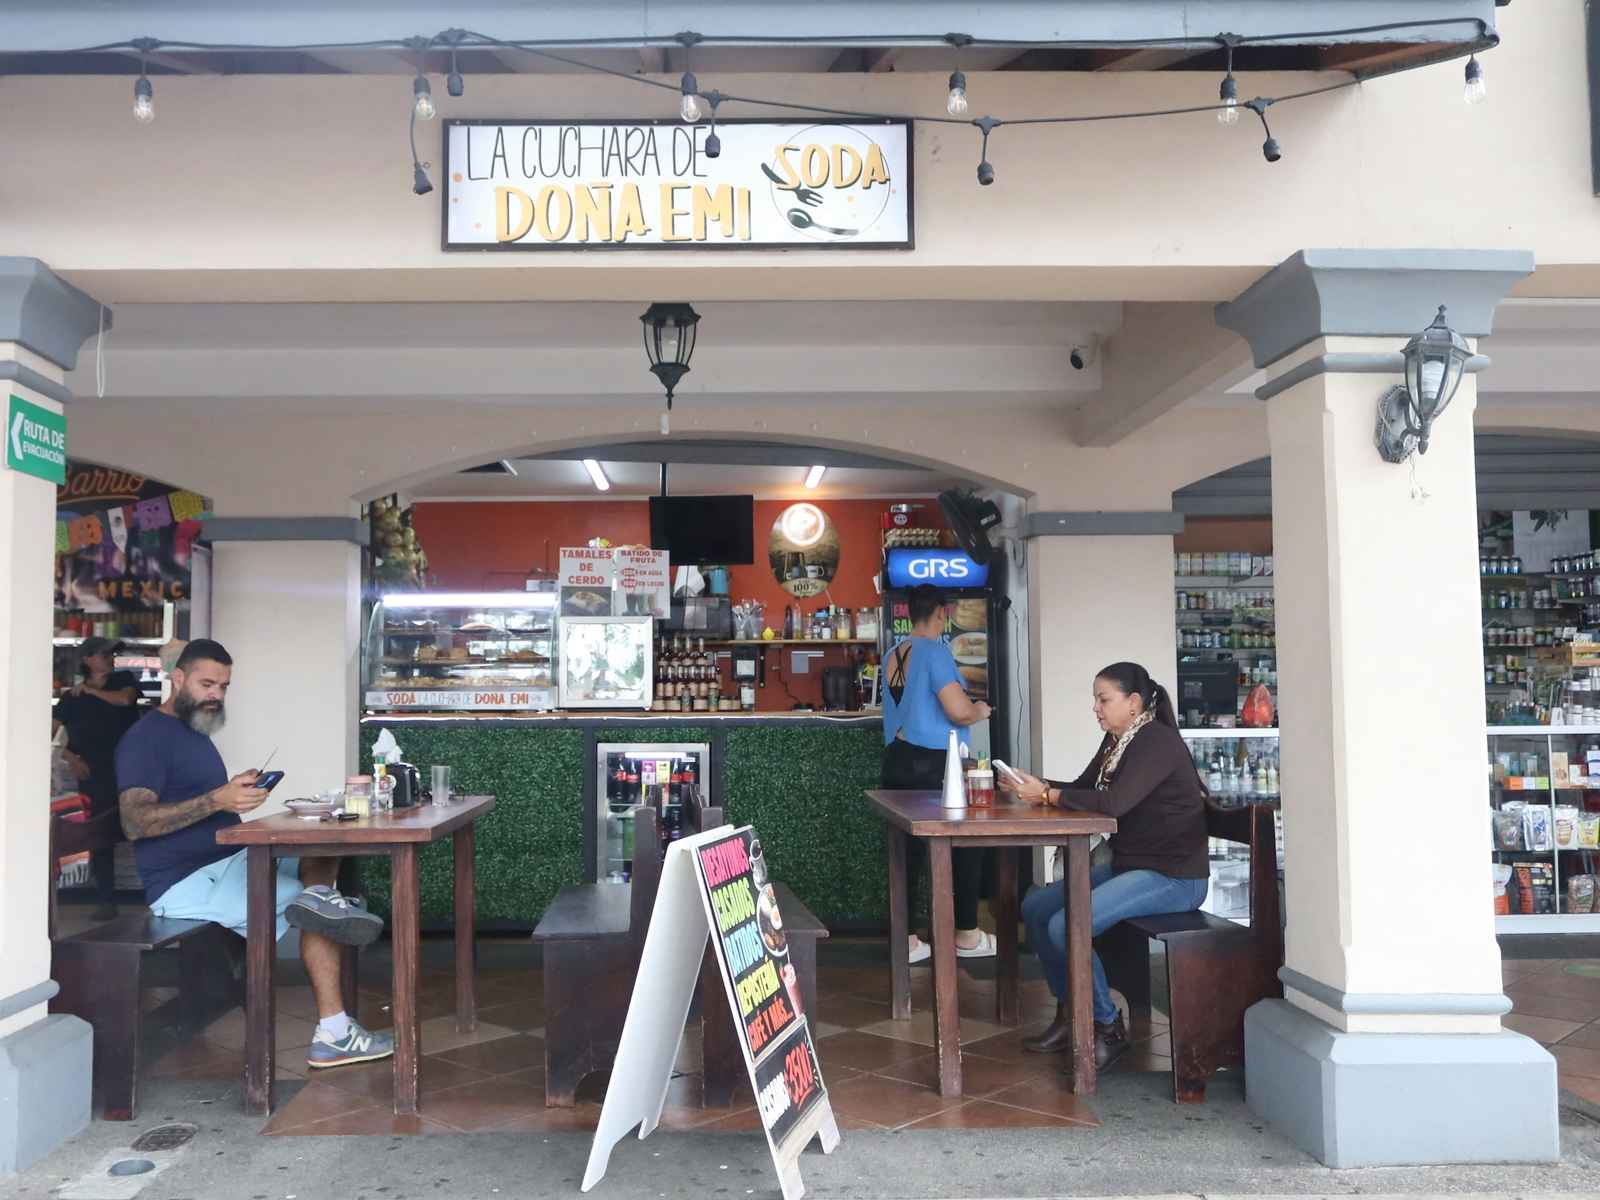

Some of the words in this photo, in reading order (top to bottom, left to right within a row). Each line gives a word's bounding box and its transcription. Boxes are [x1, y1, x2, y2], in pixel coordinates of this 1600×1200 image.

[467, 126, 509, 180] LA
[521, 127, 660, 178] CUCHARA
[673, 127, 708, 177] DE
[774, 144, 890, 190] SODA
[495, 181, 652, 243] DOÑA
[661, 183, 751, 242] EMI
[23, 419, 50, 444] RUTA
[51, 429, 65, 450] DE
[58, 463, 143, 495] arrio
[561, 549, 613, 560] TAMALES
[579, 562, 593, 572] DE
[908, 558, 969, 579] GRS
[96, 580, 186, 600] MEXIC
[568, 575, 605, 585] CERDO
[386, 692, 417, 705] SODA
[510, 692, 529, 705] EMI
[713, 877, 756, 933] CASADOS
[724, 920, 764, 978] BATIDOS
